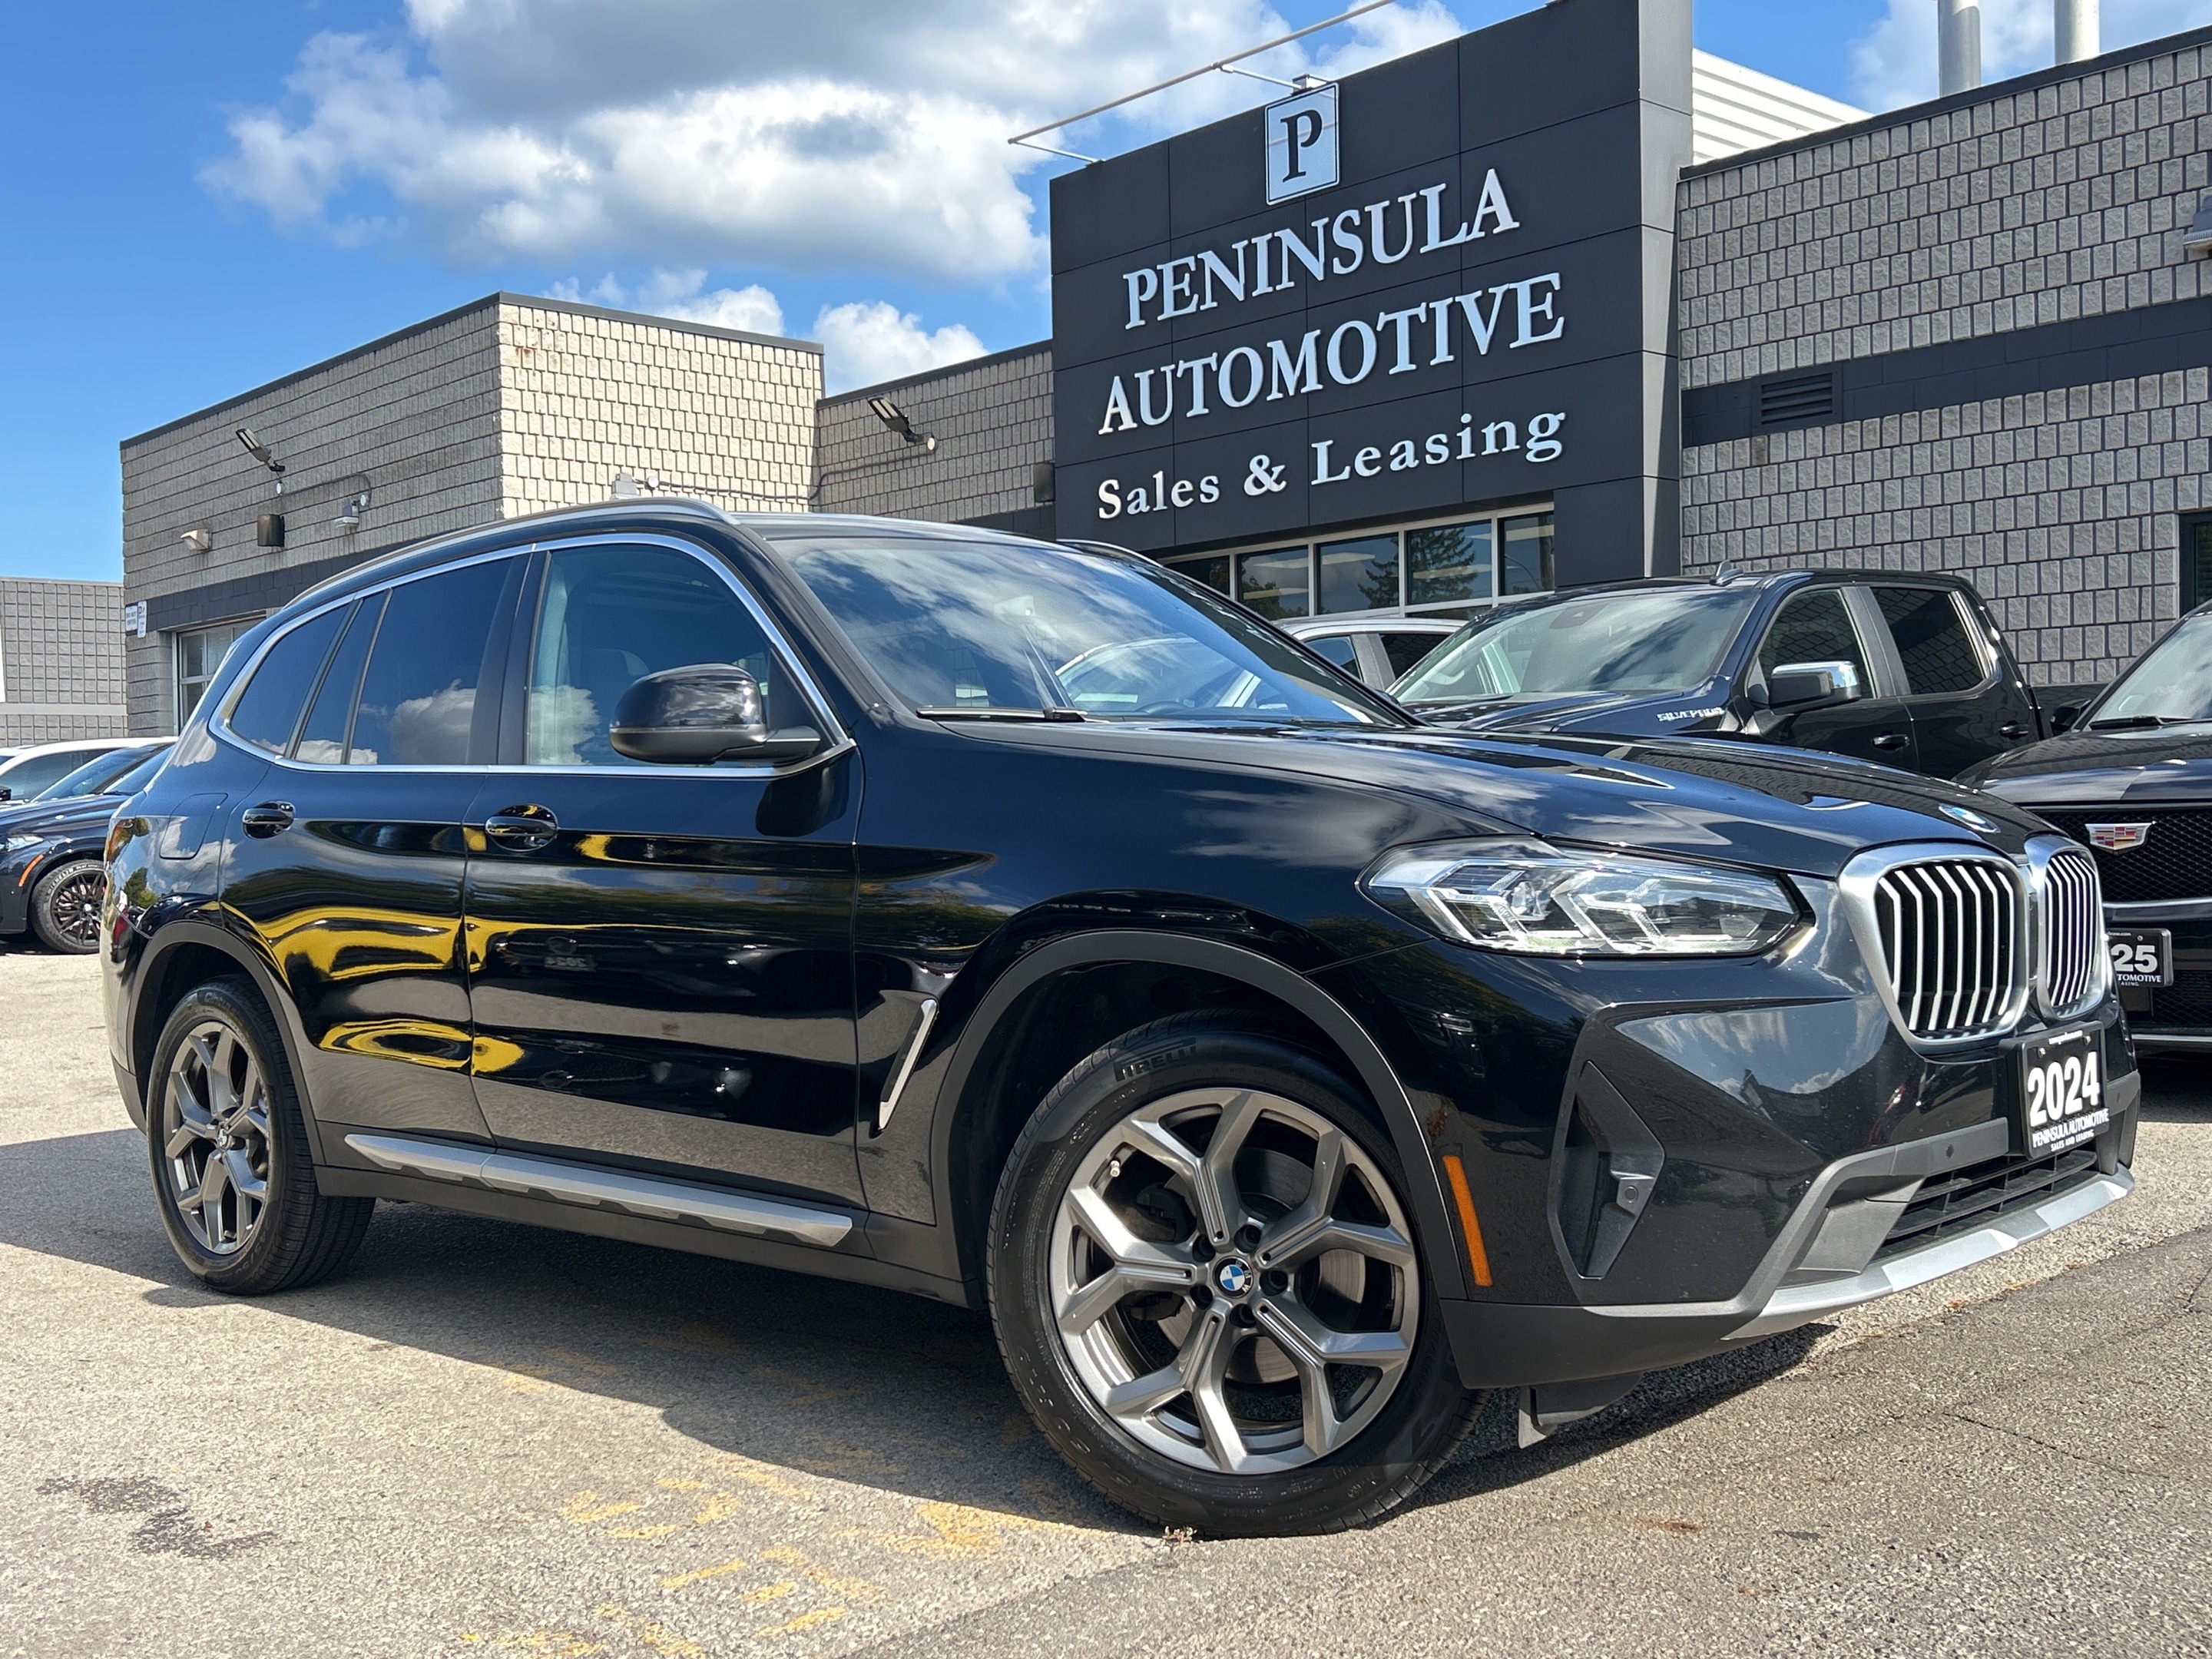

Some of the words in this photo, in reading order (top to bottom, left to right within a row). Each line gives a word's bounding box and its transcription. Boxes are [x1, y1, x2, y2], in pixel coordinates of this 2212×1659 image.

[1280, 109, 1323, 183] P
[1122, 168, 1520, 330] PENINSULA
[1098, 272, 1565, 435] AUTOMOTIVE
[1098, 469, 1221, 519] Sales
[1243, 454, 1287, 496] &
[1310, 412, 1566, 485] Leasing
[2111, 943, 2158, 973] 25
[2116, 973, 2161, 982] TOMOTIVE
[1114, 1037, 1197, 1082] PIRELLI
[2027, 1051, 2100, 1128] 2024
[2032, 1121, 2069, 1148] PENINSULA
[2069, 1108, 2110, 1135] AUTOMOTIVE
